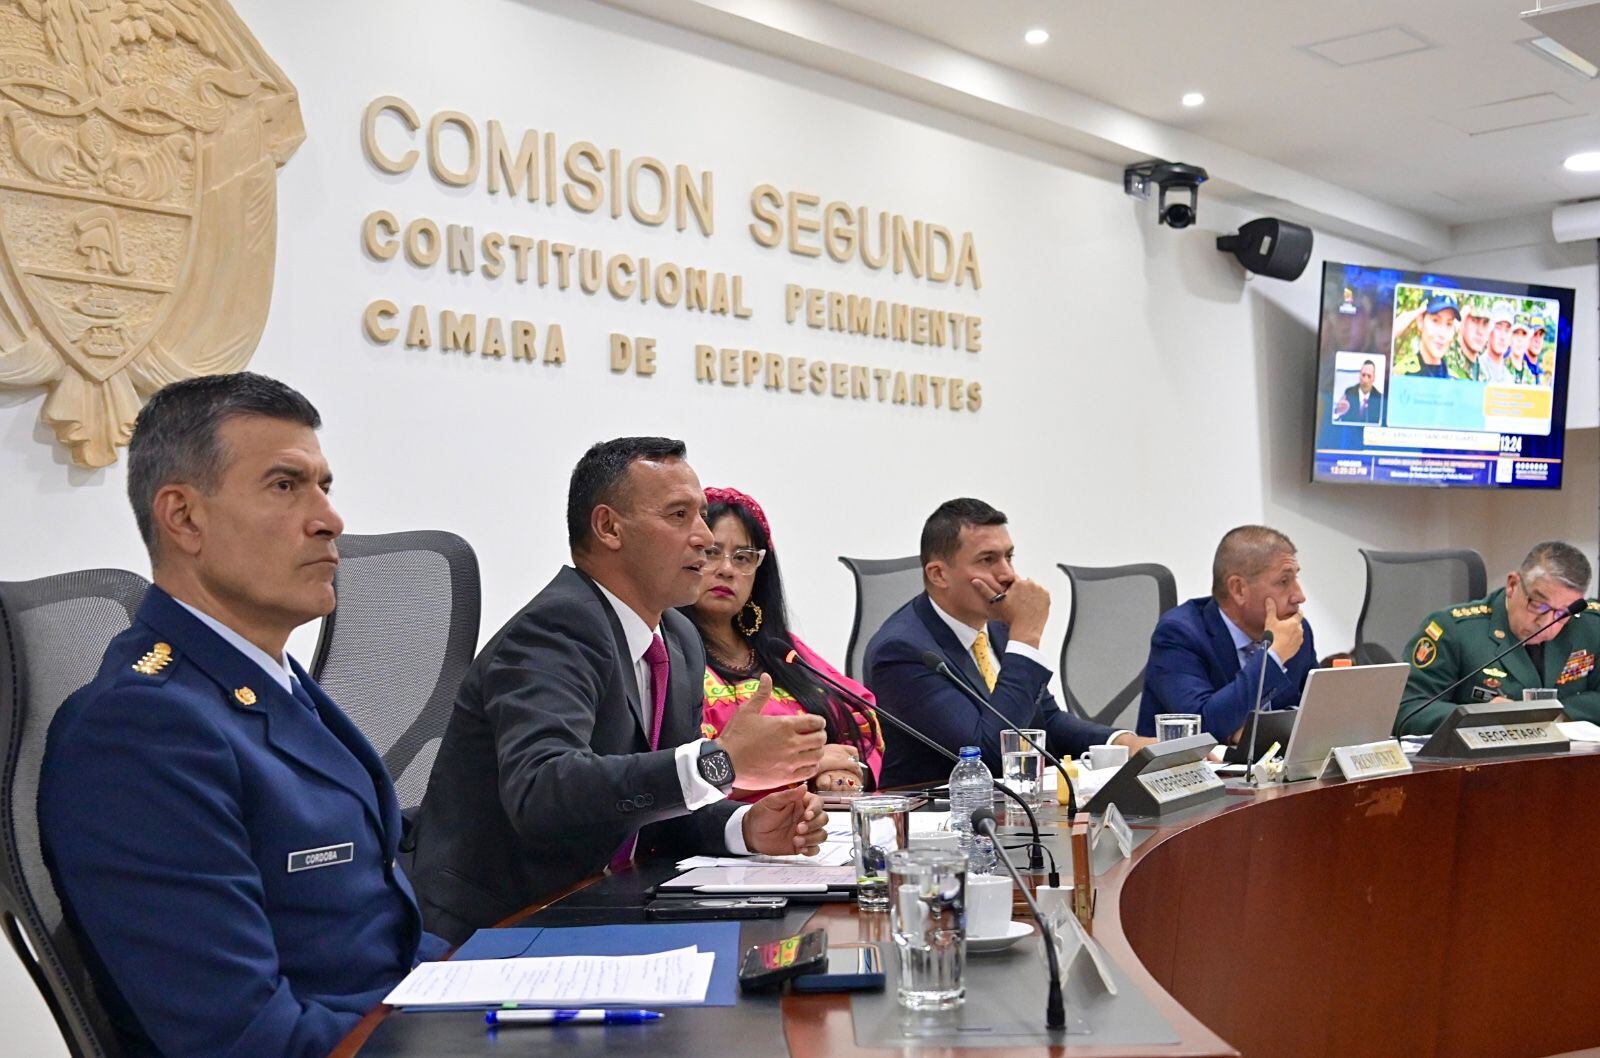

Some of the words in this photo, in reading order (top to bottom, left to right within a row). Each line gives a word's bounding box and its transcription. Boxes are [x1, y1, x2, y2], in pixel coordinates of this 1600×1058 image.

[364, 95, 714, 236] COMISION
[749, 184, 982, 290] SEGUNDA
[364, 210, 752, 318] CONSTITUCIONAL
[785, 283, 982, 352] PERMANENTE
[364, 299, 566, 364] CAMARA
[609, 333, 657, 375] DE
[695, 344, 982, 412] REPRESENTANTES
[1478, 727, 1548, 743] SECRETARIO
[1146, 767, 1216, 794] VICEPRESIDENTE
[305, 850, 338, 865] CORDOBA
